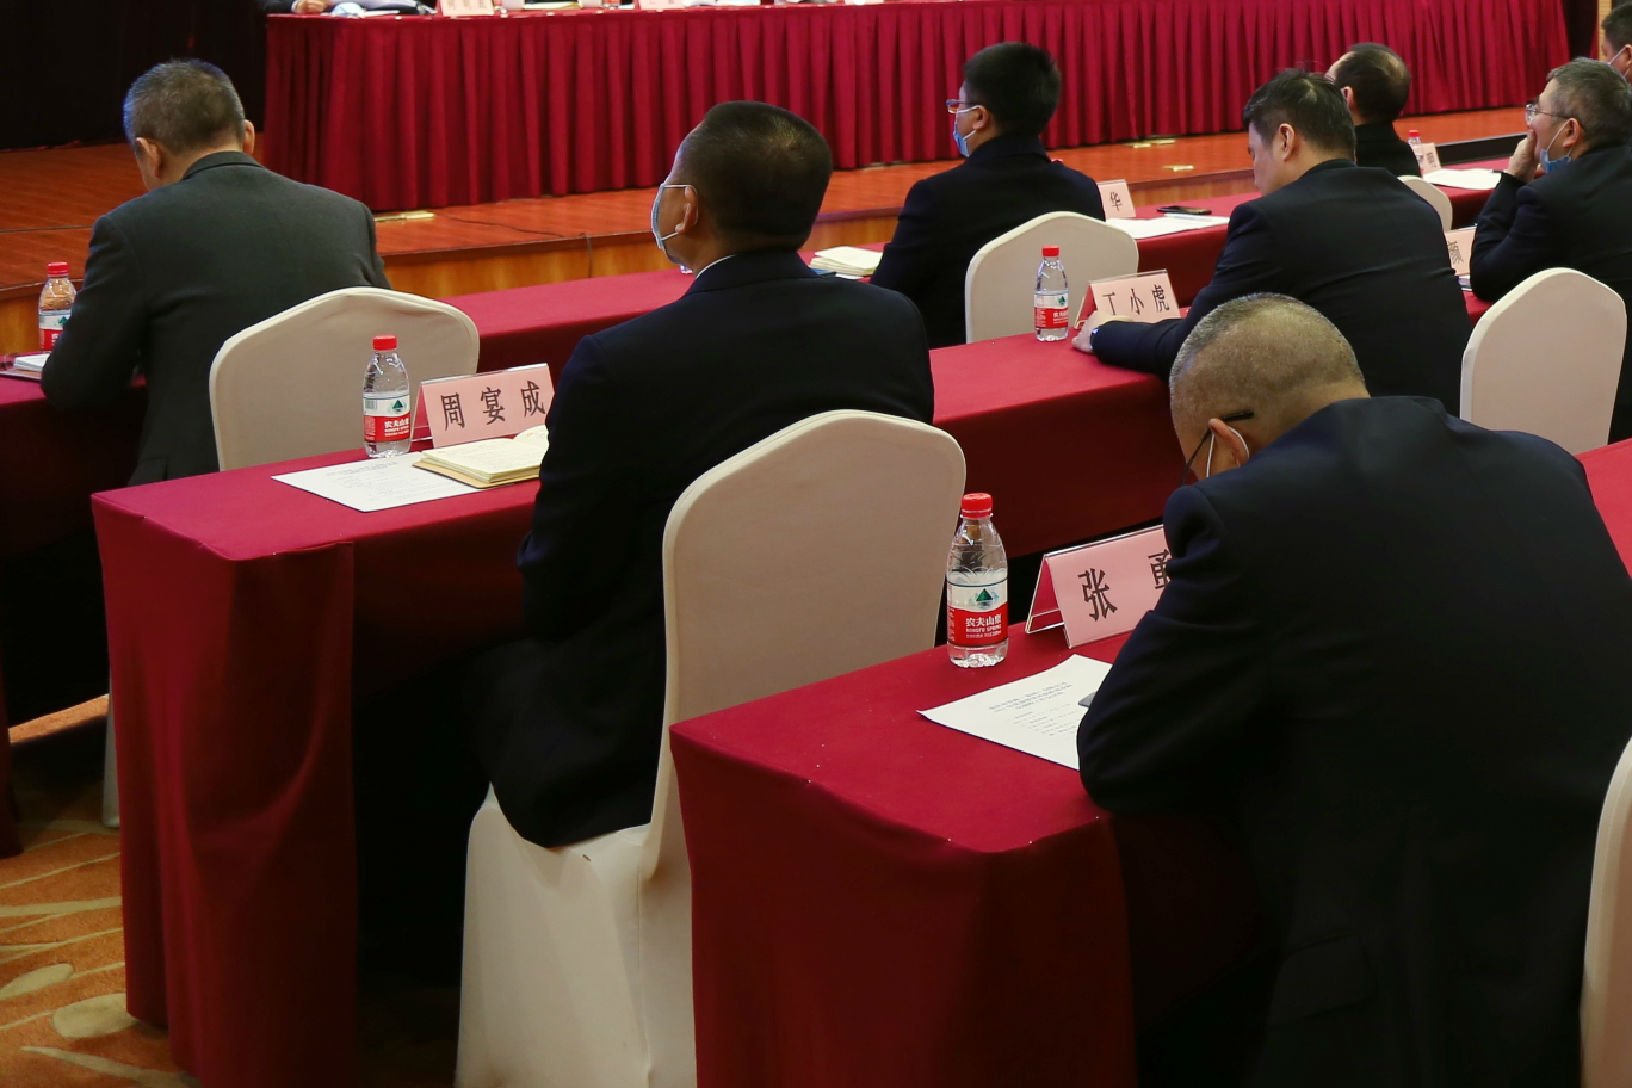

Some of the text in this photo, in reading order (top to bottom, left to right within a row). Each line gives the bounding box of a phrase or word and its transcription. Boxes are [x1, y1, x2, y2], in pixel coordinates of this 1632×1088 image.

[1101, 283, 1170, 316] 丁小虎
[440, 380, 546, 431] 周宴成
